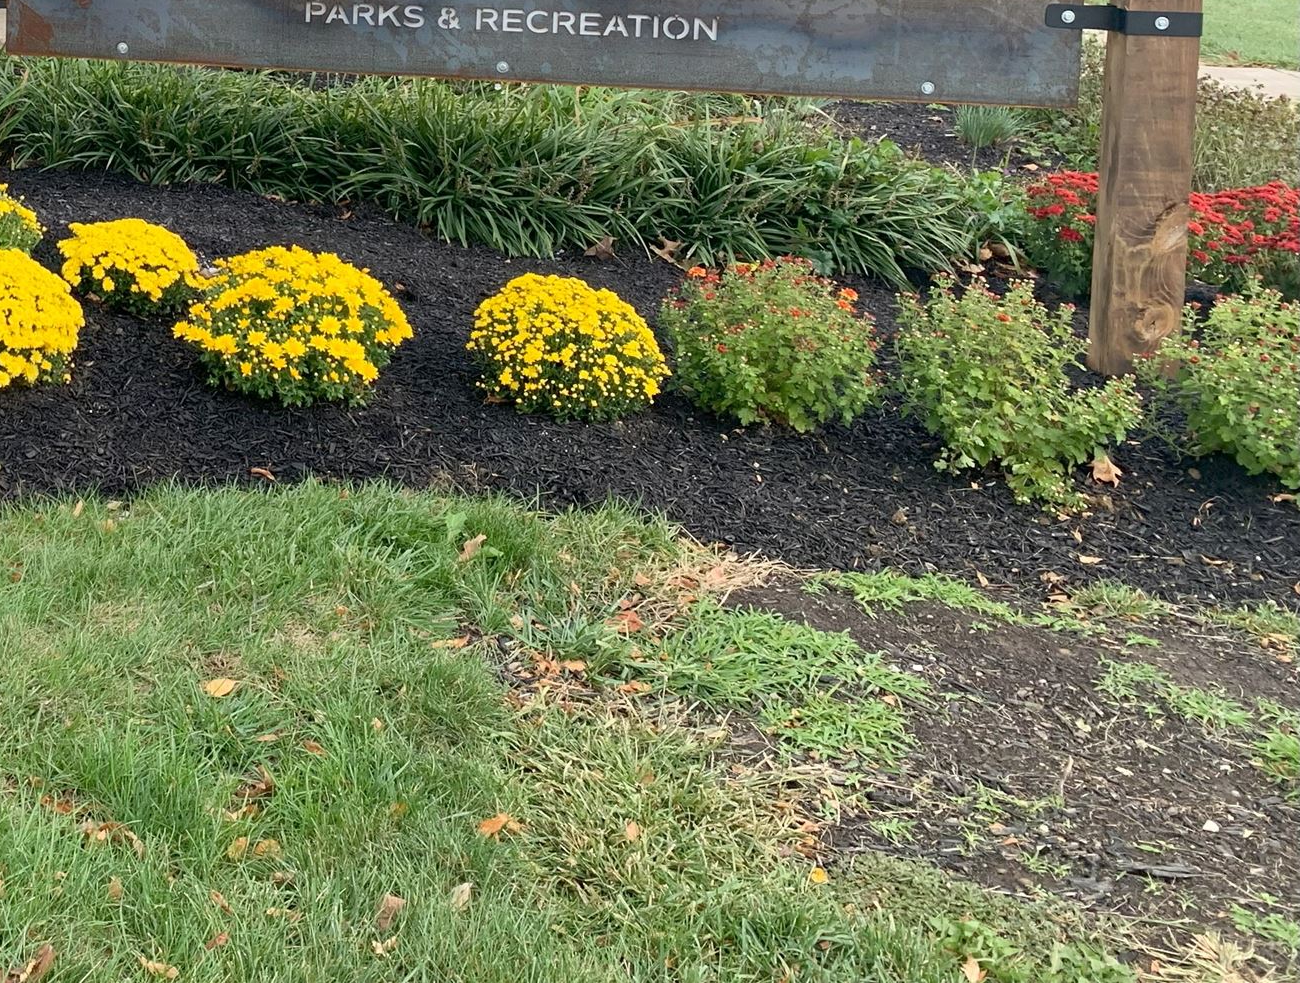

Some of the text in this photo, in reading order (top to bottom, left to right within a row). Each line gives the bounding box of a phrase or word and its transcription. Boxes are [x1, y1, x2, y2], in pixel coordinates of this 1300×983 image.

[305, 2, 720, 41] PARKS & RECREATION
